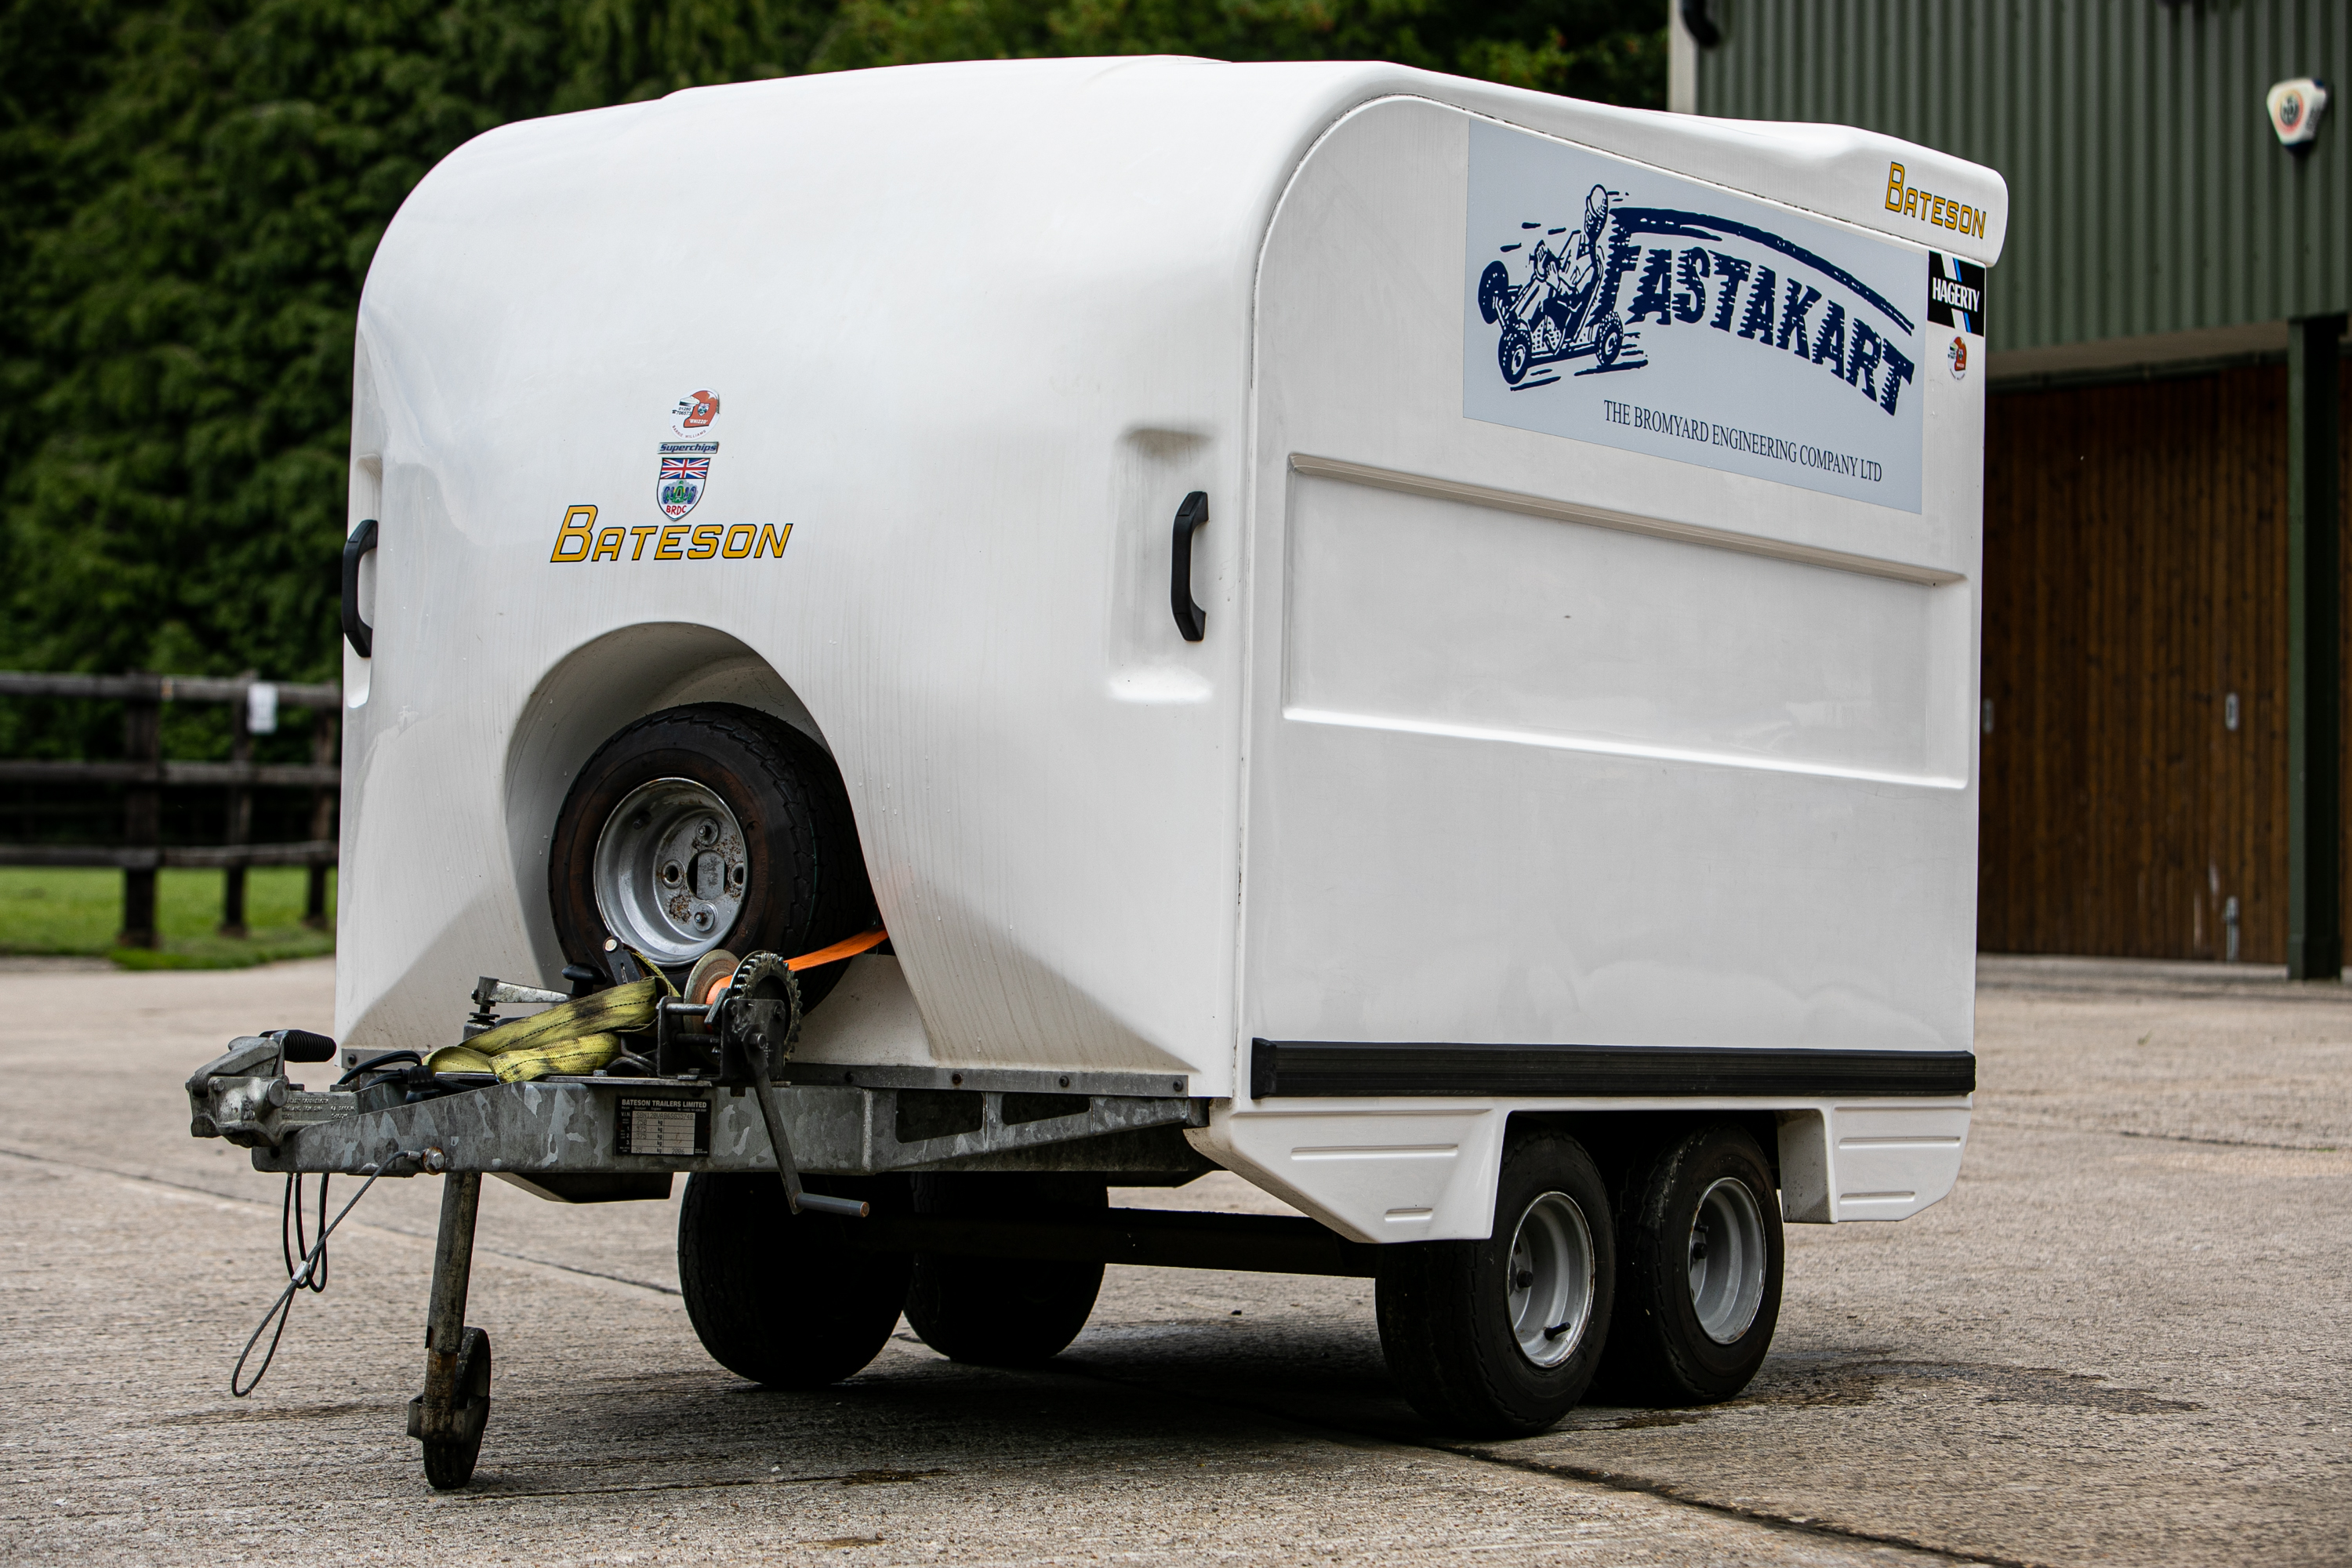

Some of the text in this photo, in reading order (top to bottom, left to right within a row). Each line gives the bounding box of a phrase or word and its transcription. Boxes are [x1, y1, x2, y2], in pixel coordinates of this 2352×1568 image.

[1932, 277, 1980, 312] HAGERTY
[1587, 229, 1915, 416] FASTAKART
[685, 430, 706, 438] WILLIAMS
[1603, 399, 1882, 482] THE BROMYARD ENGINEERING COMPANY LTD
[659, 443, 717, 453] Superchips
[666, 505, 687, 516] BRDC
